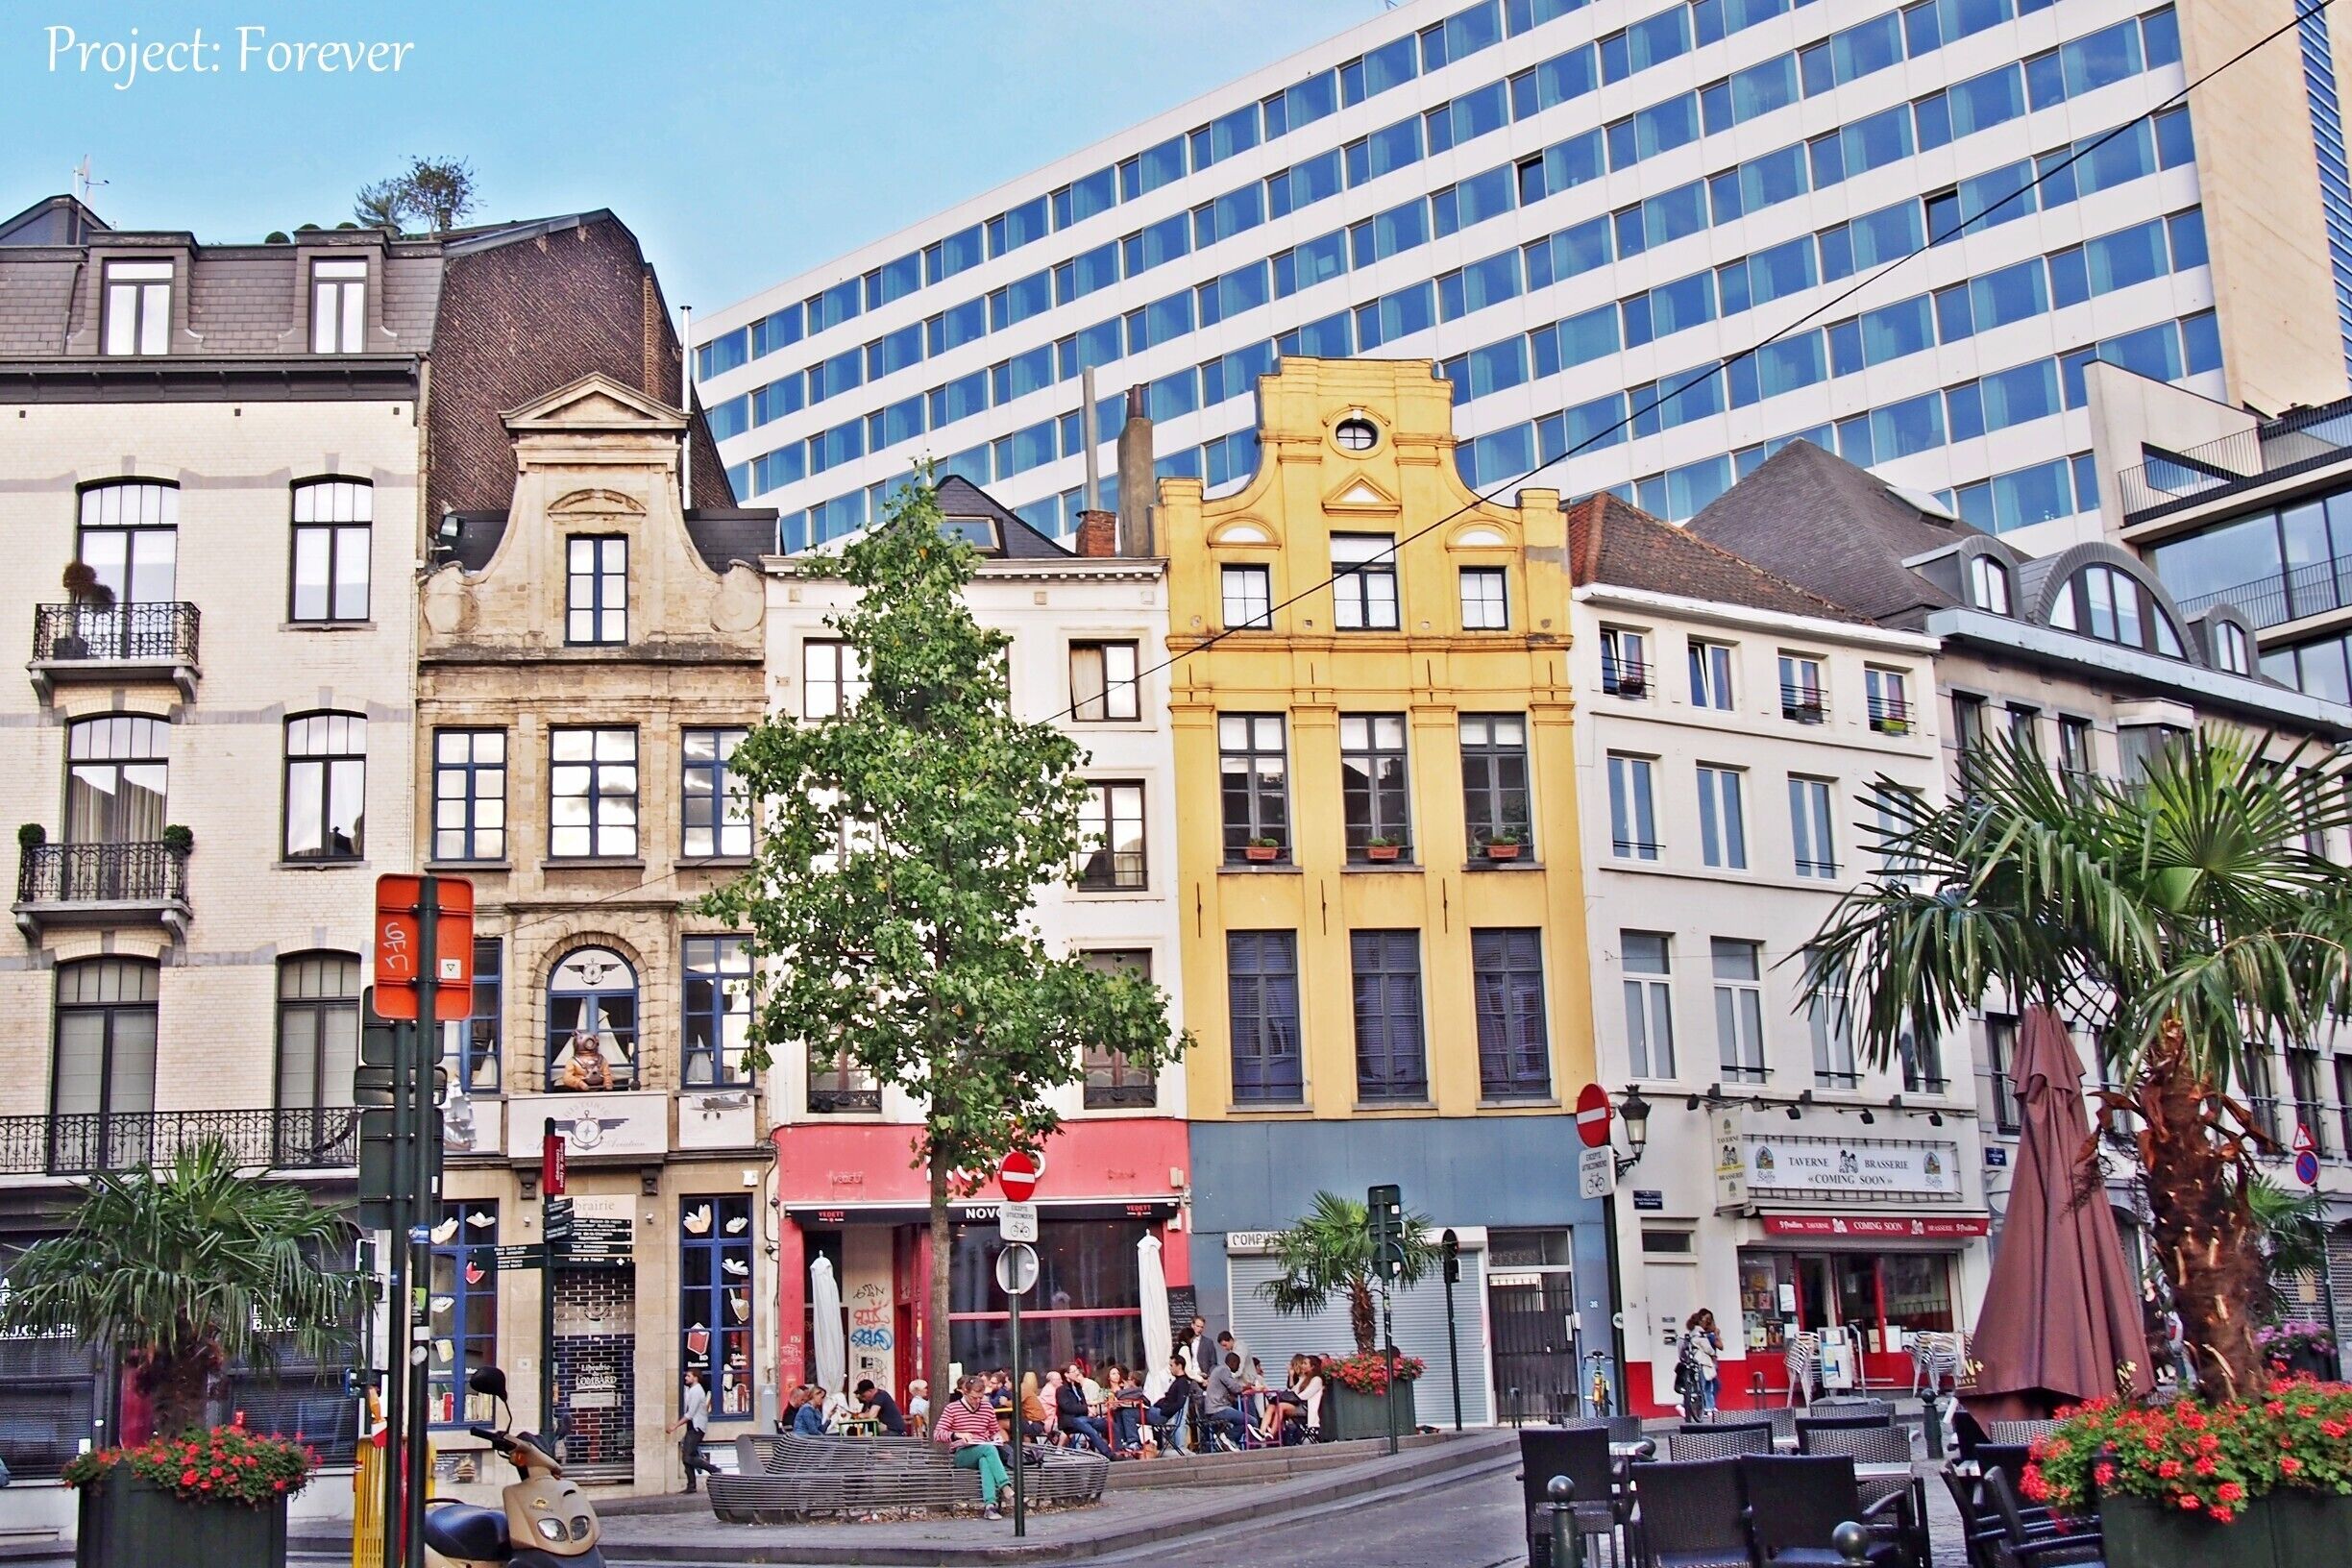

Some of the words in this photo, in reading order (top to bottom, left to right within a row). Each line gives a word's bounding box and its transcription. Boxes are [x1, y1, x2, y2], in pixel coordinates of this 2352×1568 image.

[1788, 1157, 1829, 1167] TAVERNE
[1864, 1159, 1909, 1170] BRASSERIE
[1853, 1221, 1882, 1230] COMING
[576, 1375, 618, 1386] LOMBARD
